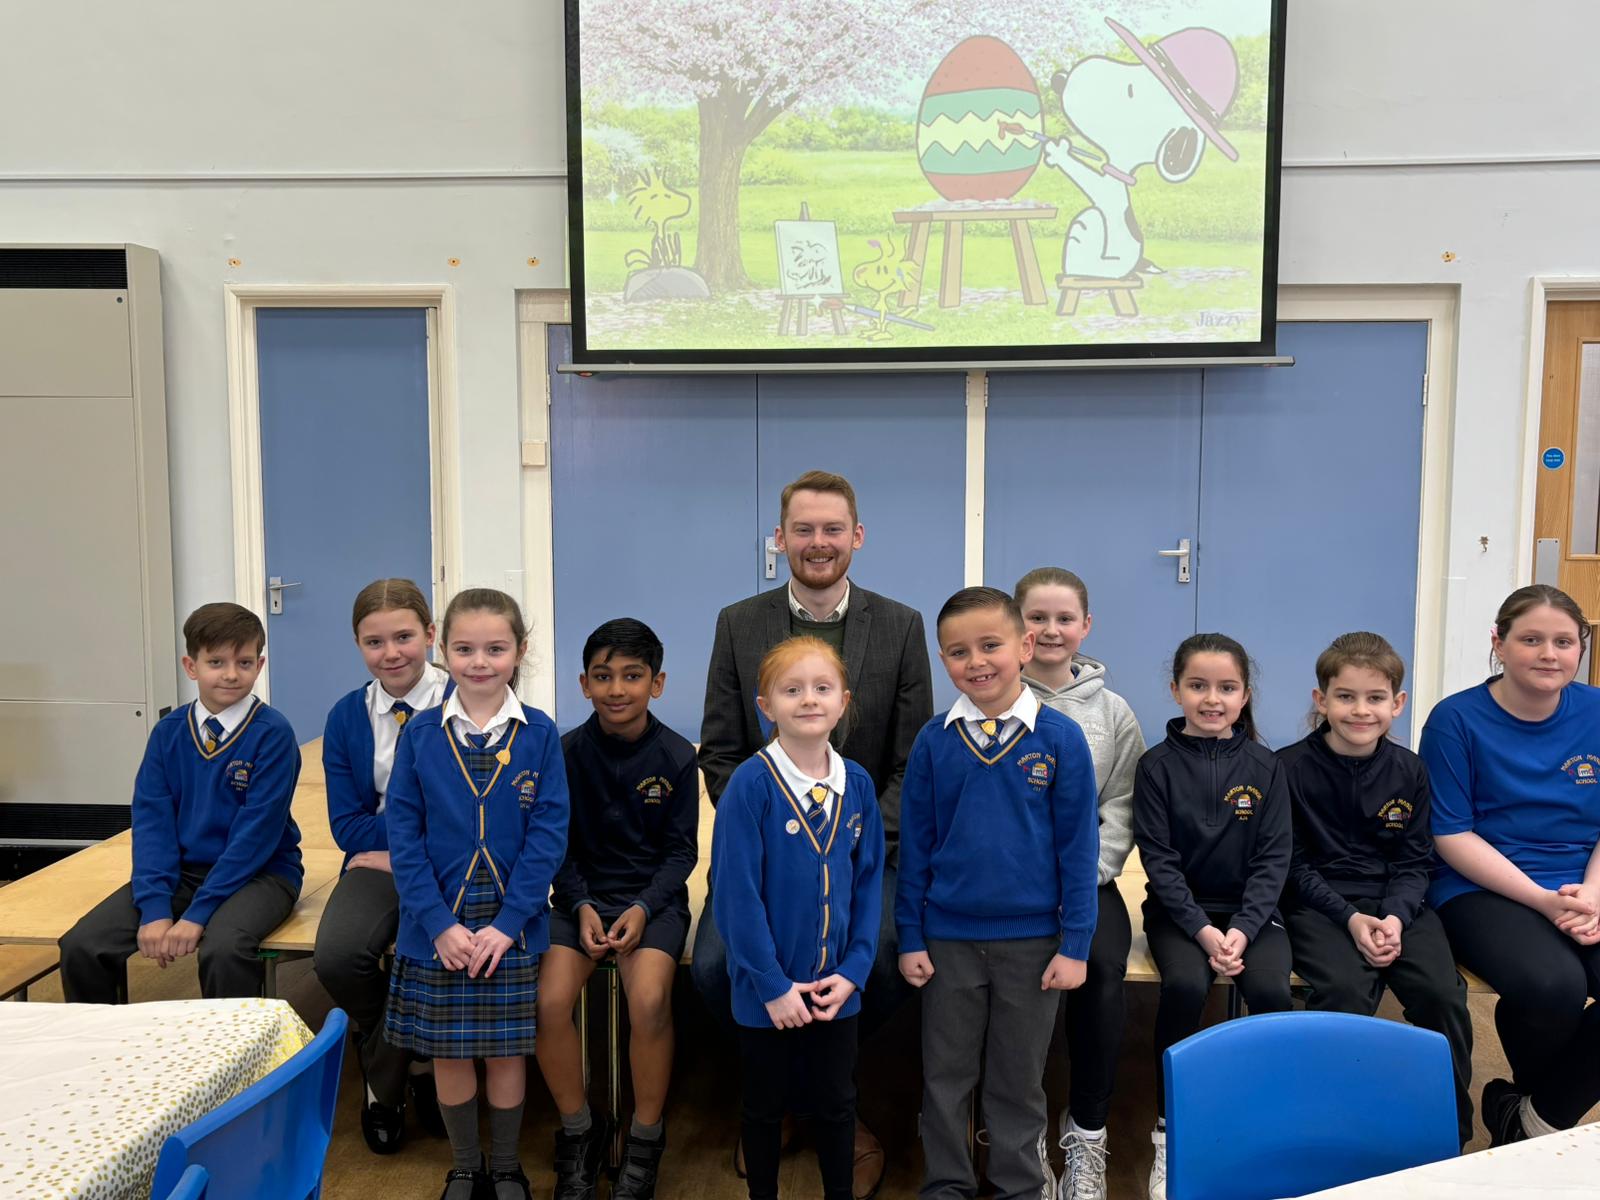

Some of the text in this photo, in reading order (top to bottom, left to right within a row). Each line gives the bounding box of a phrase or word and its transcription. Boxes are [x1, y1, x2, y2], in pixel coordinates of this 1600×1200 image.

[1196, 312, 1244, 331] Jazzy
[1561, 755, 1583, 771] MARTON
[1027, 777, 1048, 785] SCHOOL
[1223, 785, 1244, 801] MARTON
